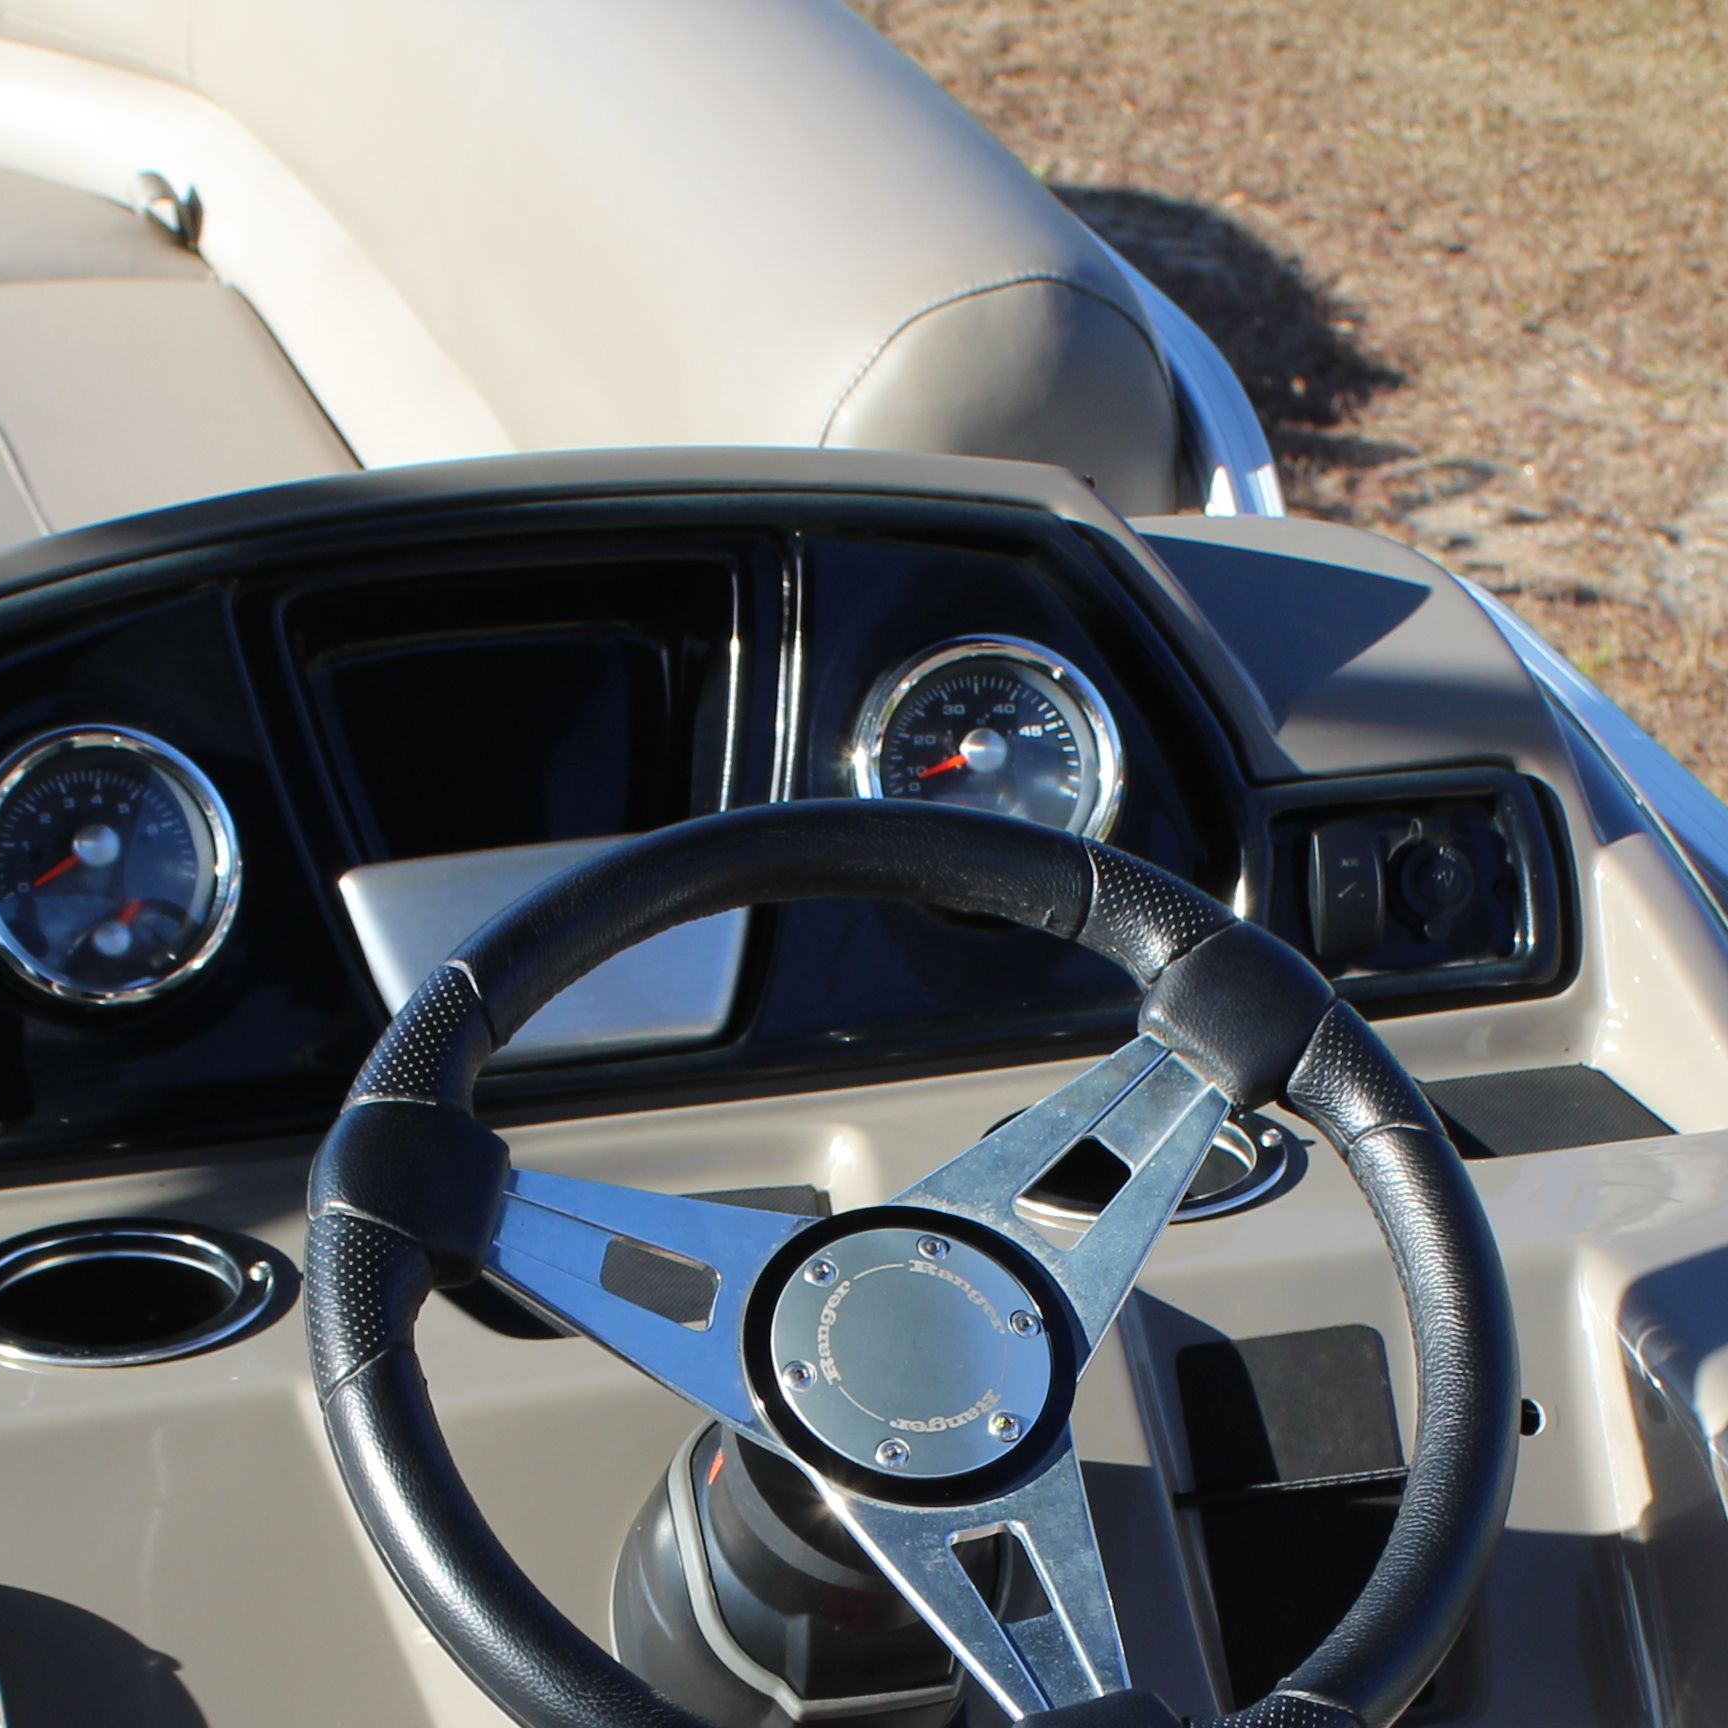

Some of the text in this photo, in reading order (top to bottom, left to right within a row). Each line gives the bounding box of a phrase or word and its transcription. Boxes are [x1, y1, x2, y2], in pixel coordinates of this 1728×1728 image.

[943, 704, 965, 714] 30
[993, 704, 1015, 714] 40
[1018, 725, 1043, 737] 45
[913, 735, 936, 745] 20
[90, 793, 103, 804] 4
[908, 1258, 1006, 1334] Ranger
[817, 1279, 852, 1385] Ranger
[889, 1389, 1002, 1433] Ranger
